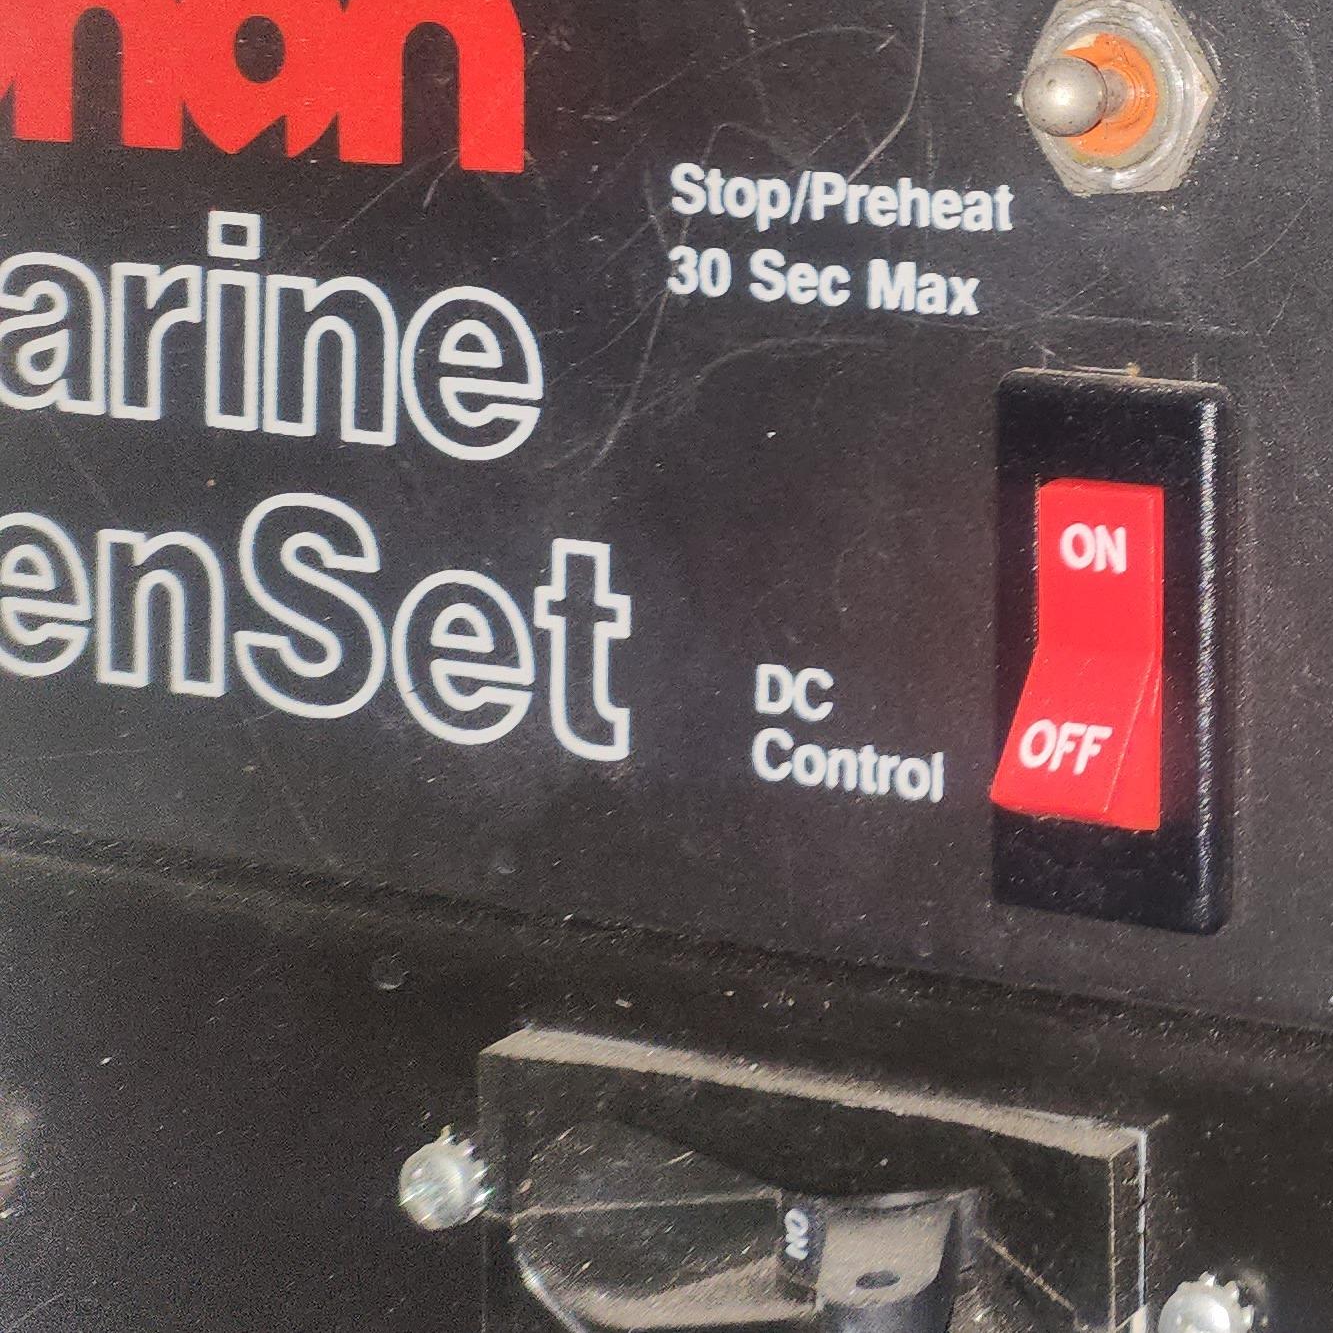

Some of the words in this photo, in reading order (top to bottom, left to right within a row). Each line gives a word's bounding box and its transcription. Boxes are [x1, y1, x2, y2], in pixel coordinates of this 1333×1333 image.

[670, 161, 1015, 233] Stop/Preheat
[667, 244, 732, 299] 30
[749, 247, 851, 308] Sec
[867, 258, 981, 317] Max
[1058, 521, 1128, 575] ON
[754, 662, 835, 723] DC
[751, 727, 945, 804] Control
[1017, 717, 1113, 774] OFF
